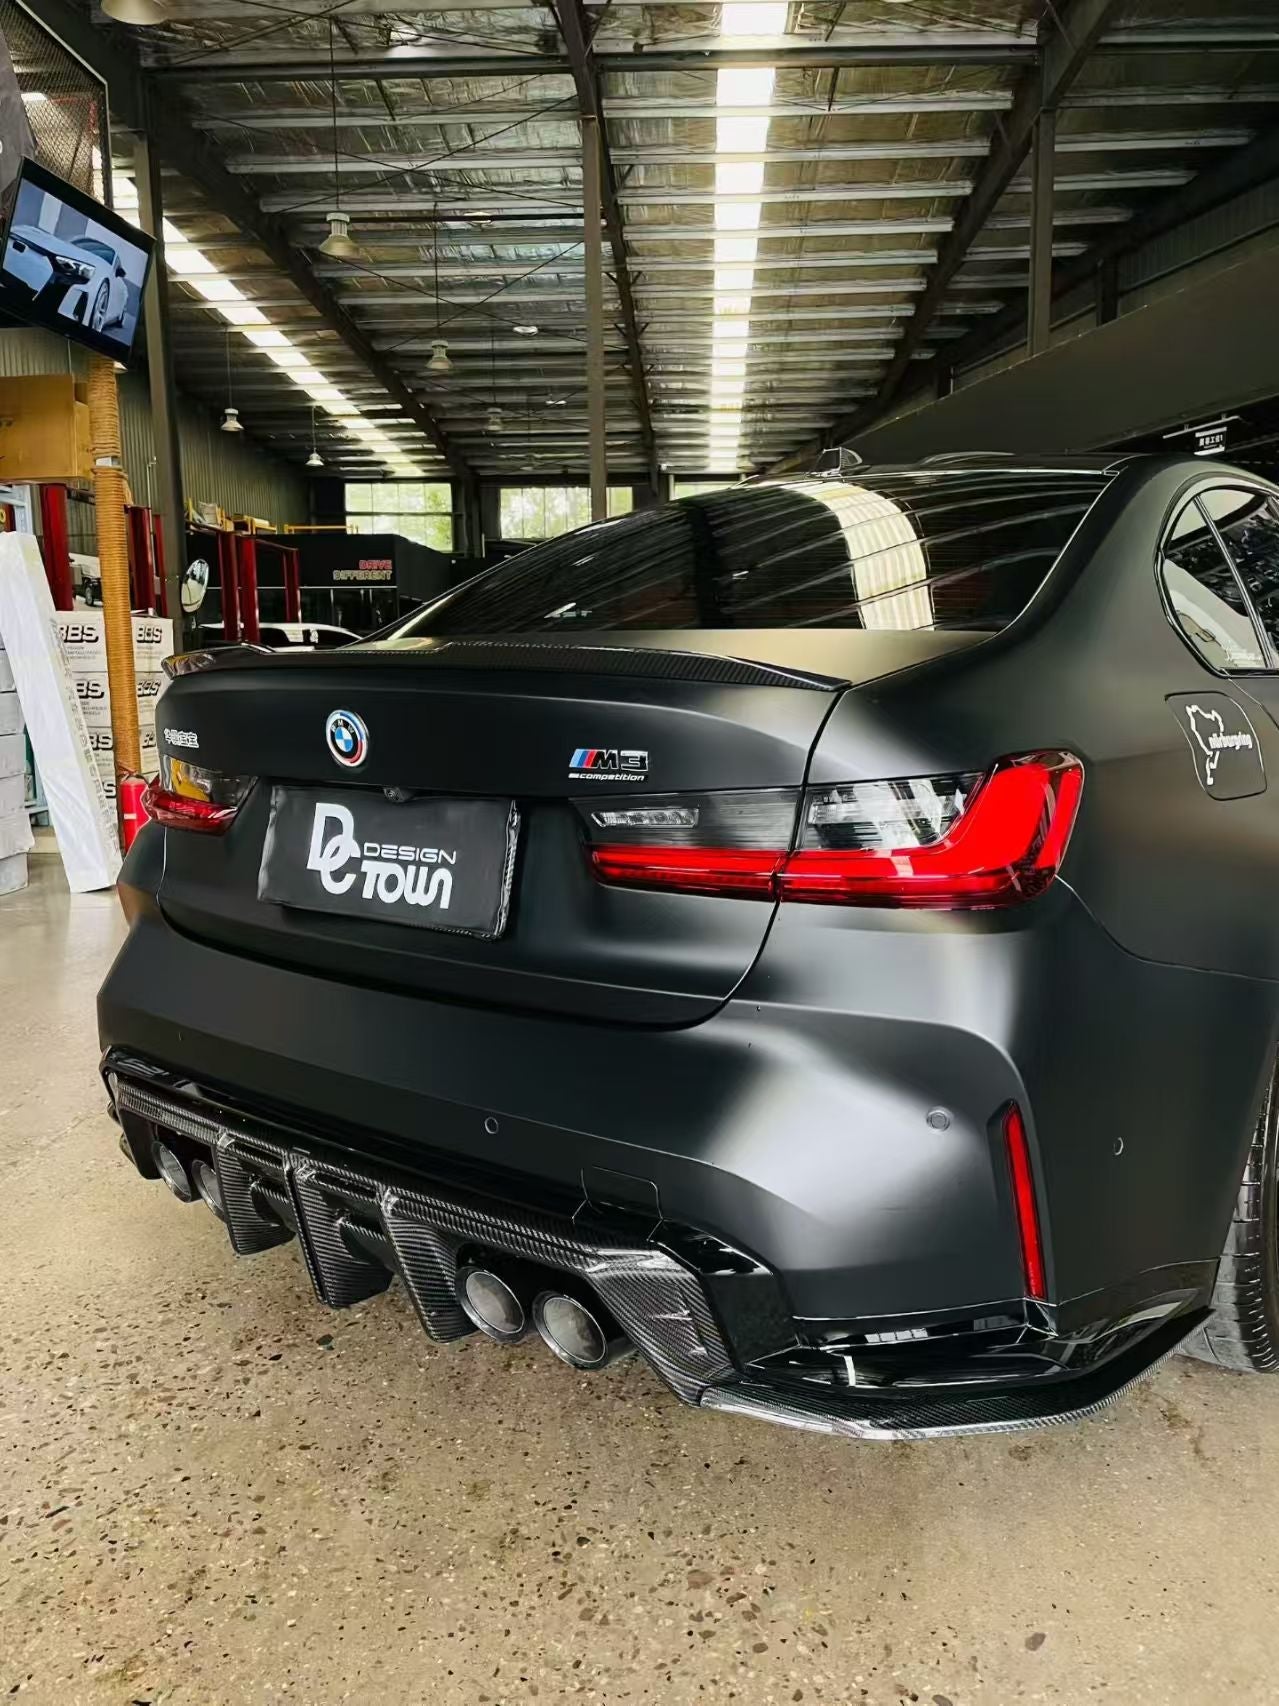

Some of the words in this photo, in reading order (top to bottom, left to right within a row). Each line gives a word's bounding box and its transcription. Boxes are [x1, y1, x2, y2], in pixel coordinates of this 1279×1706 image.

[333, 569, 392, 581] DIFFERENT
[136, 624, 163, 643] BBS
[76, 681, 104, 699] BS
[331, 719, 355, 733] BMW
[89, 733, 113, 751] BS
[590, 749, 648, 772] M3
[579, 773, 645, 782] competition
[363, 842, 457, 864] DESIGN
